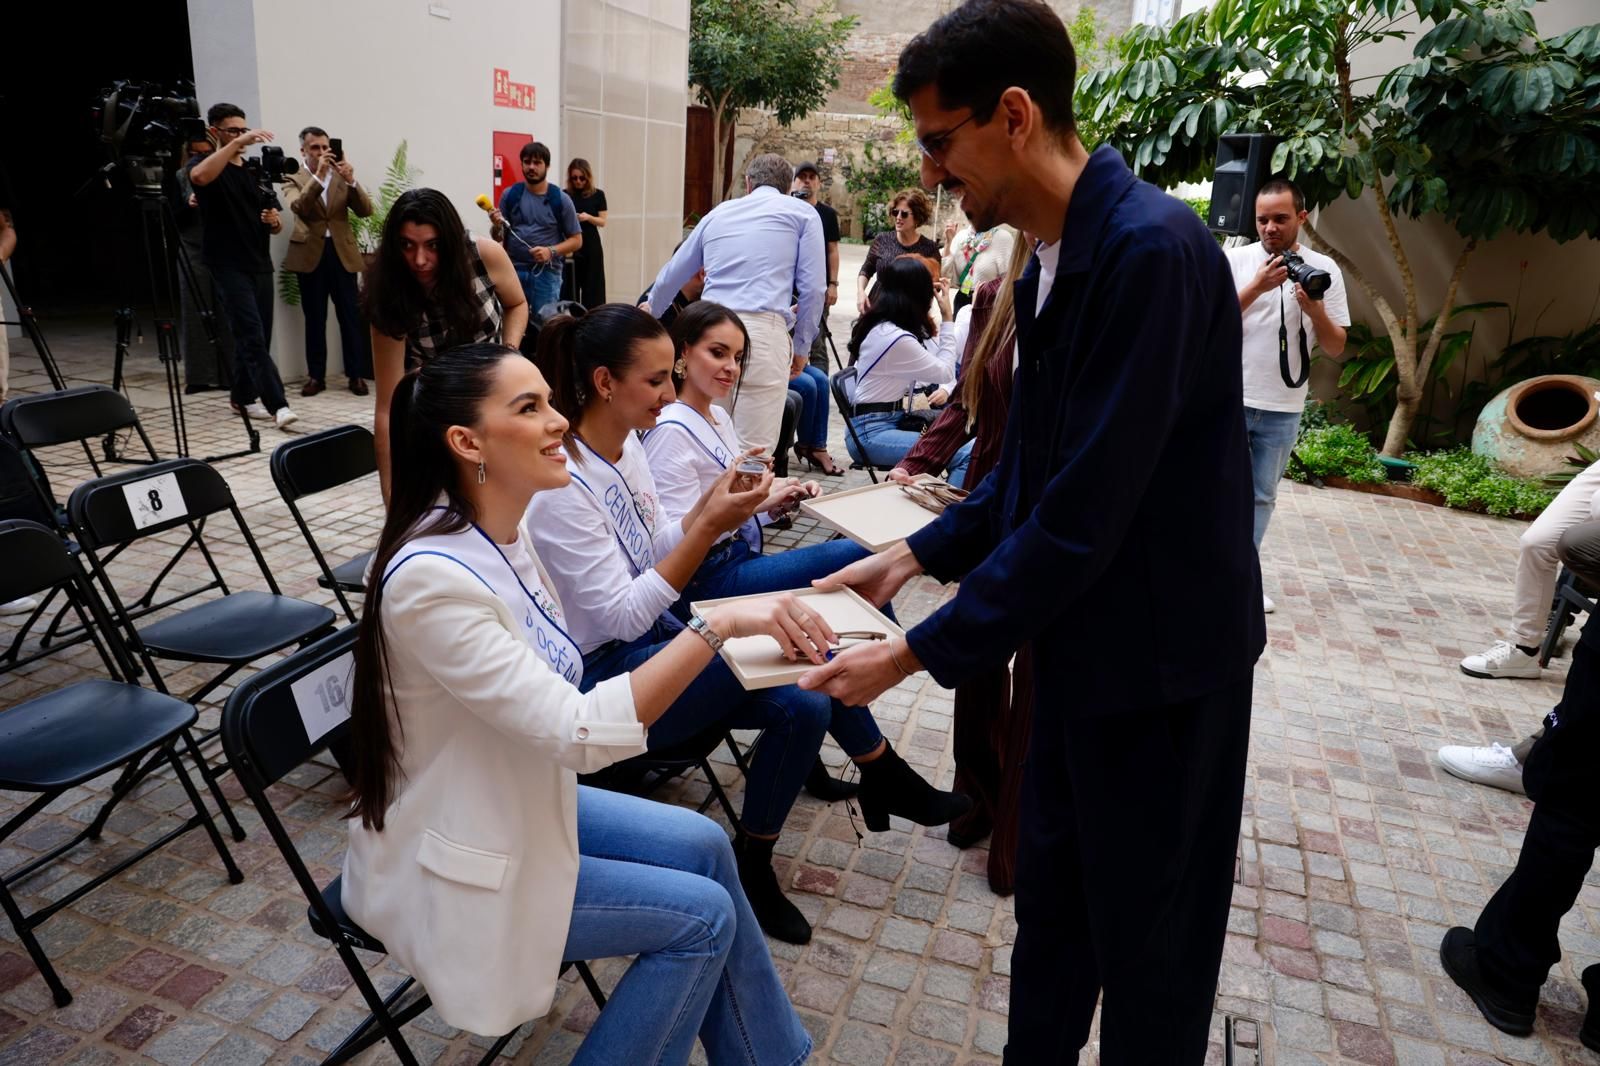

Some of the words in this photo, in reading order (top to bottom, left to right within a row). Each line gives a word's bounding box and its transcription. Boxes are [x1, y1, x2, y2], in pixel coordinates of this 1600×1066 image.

[148, 489, 163, 511] 8
[604, 484, 643, 555] CENTRO
[314, 675, 345, 714] 16
